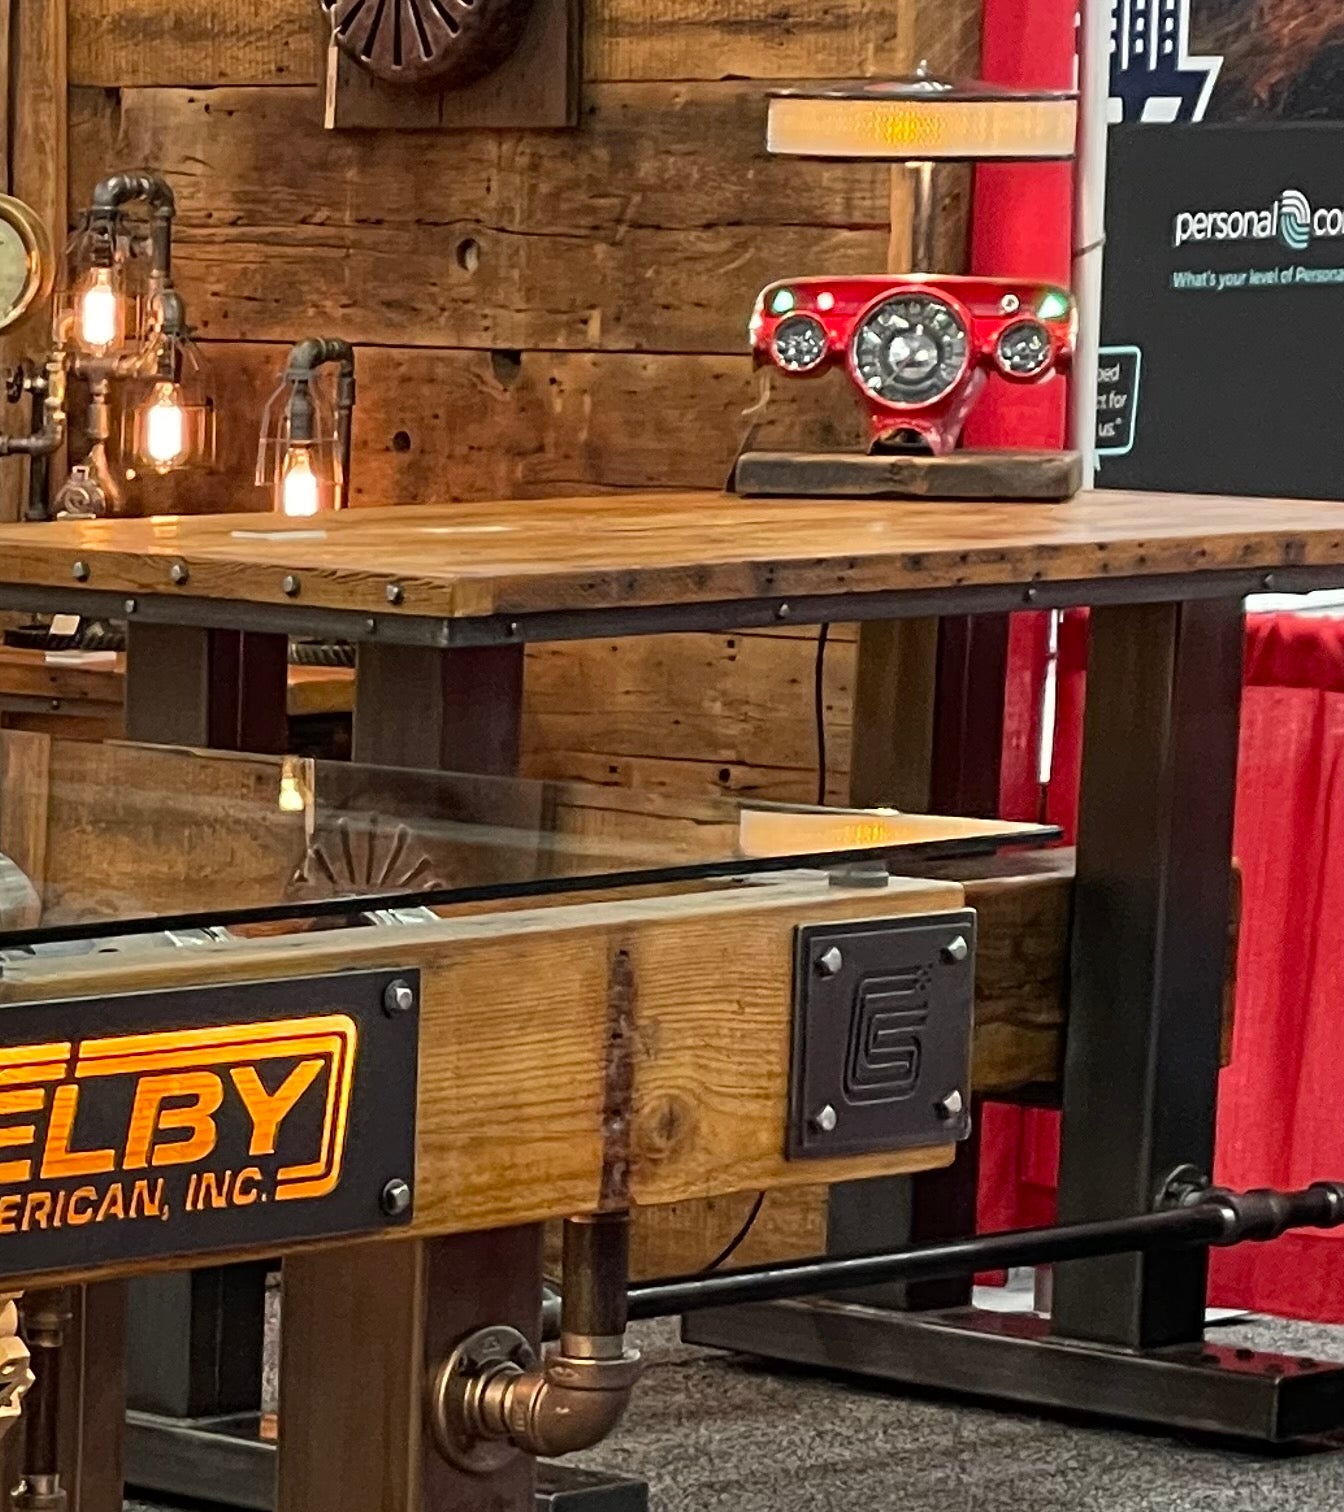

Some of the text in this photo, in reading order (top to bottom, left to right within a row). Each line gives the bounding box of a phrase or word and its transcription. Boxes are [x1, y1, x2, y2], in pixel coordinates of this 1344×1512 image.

[1175, 200, 1344, 247] personal co
[1217, 272, 1247, 290] your
[1248, 268, 1278, 285] level
[1280, 265, 1295, 284] of
[183, 1168, 271, 1211] INC.
